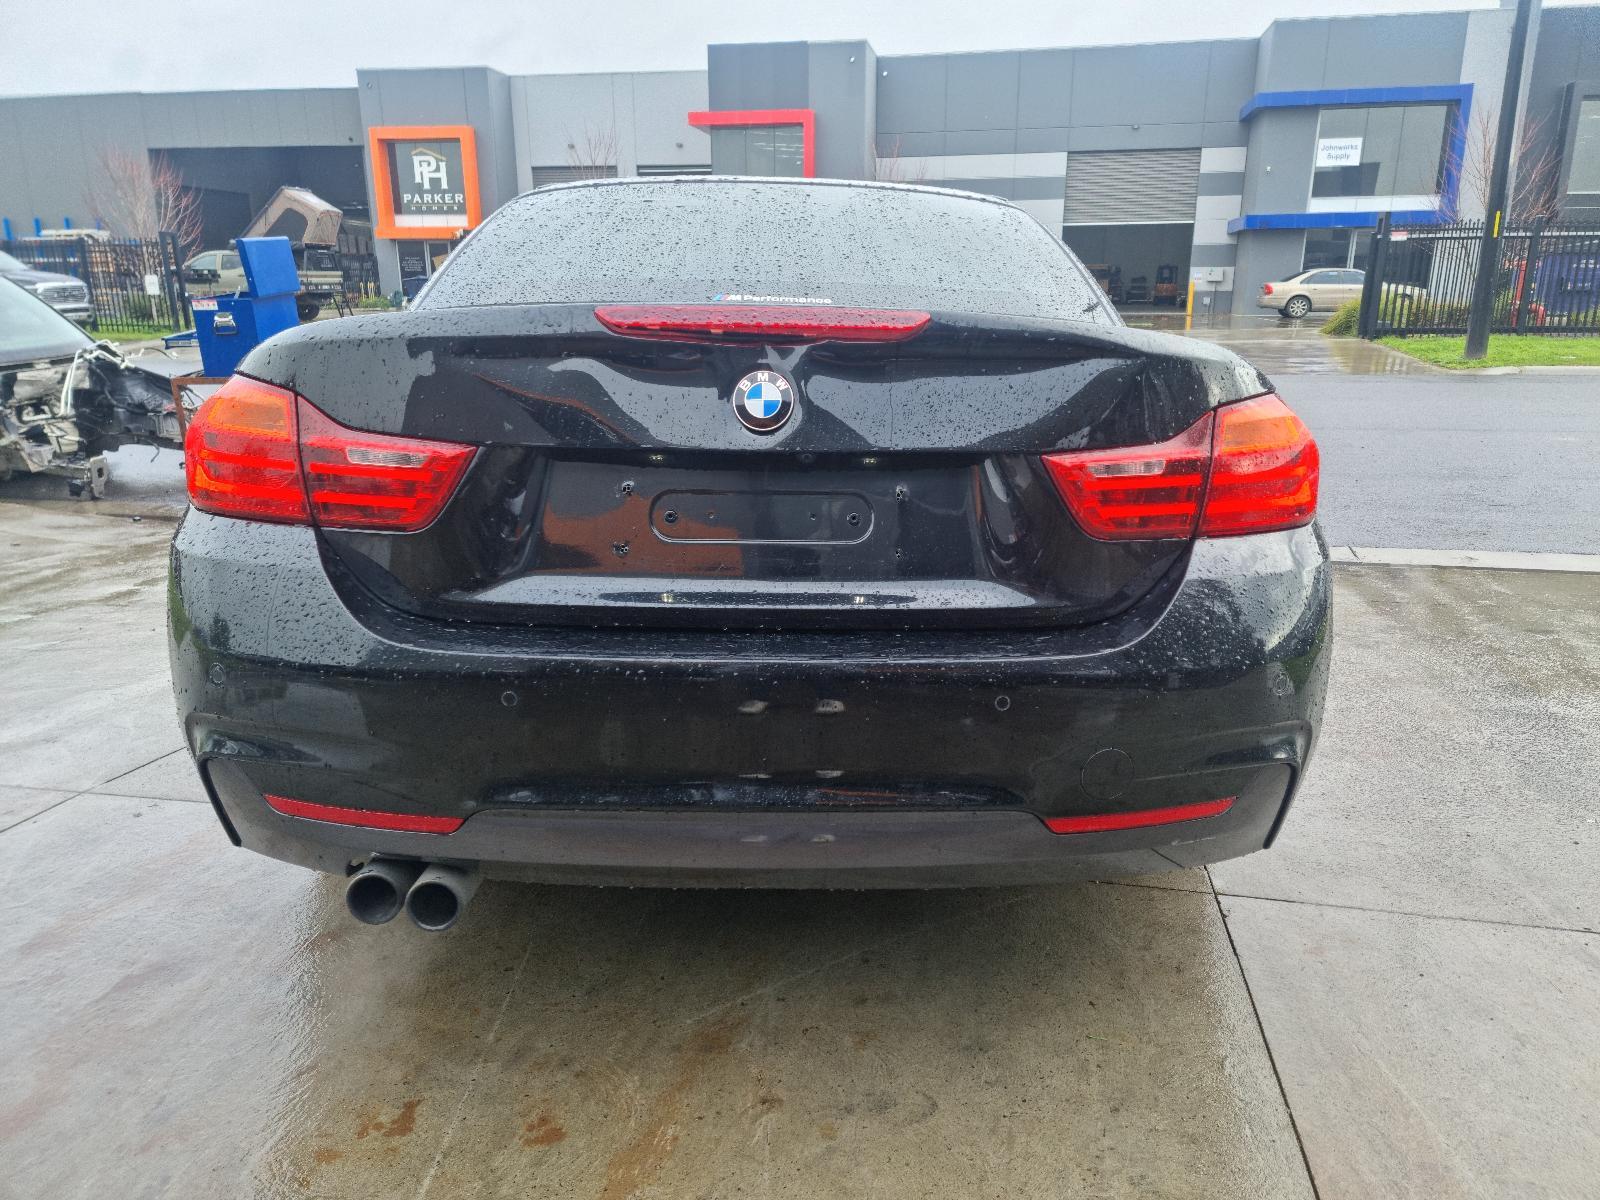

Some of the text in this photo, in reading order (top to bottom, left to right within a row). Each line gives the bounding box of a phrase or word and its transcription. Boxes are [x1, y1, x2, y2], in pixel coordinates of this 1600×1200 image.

[1326, 152, 1351, 161] Supply
[412, 156, 449, 190] PH
[403, 193, 464, 204] PARKER
[743, 294, 833, 304] Performance
[738, 372, 789, 392] BMW
